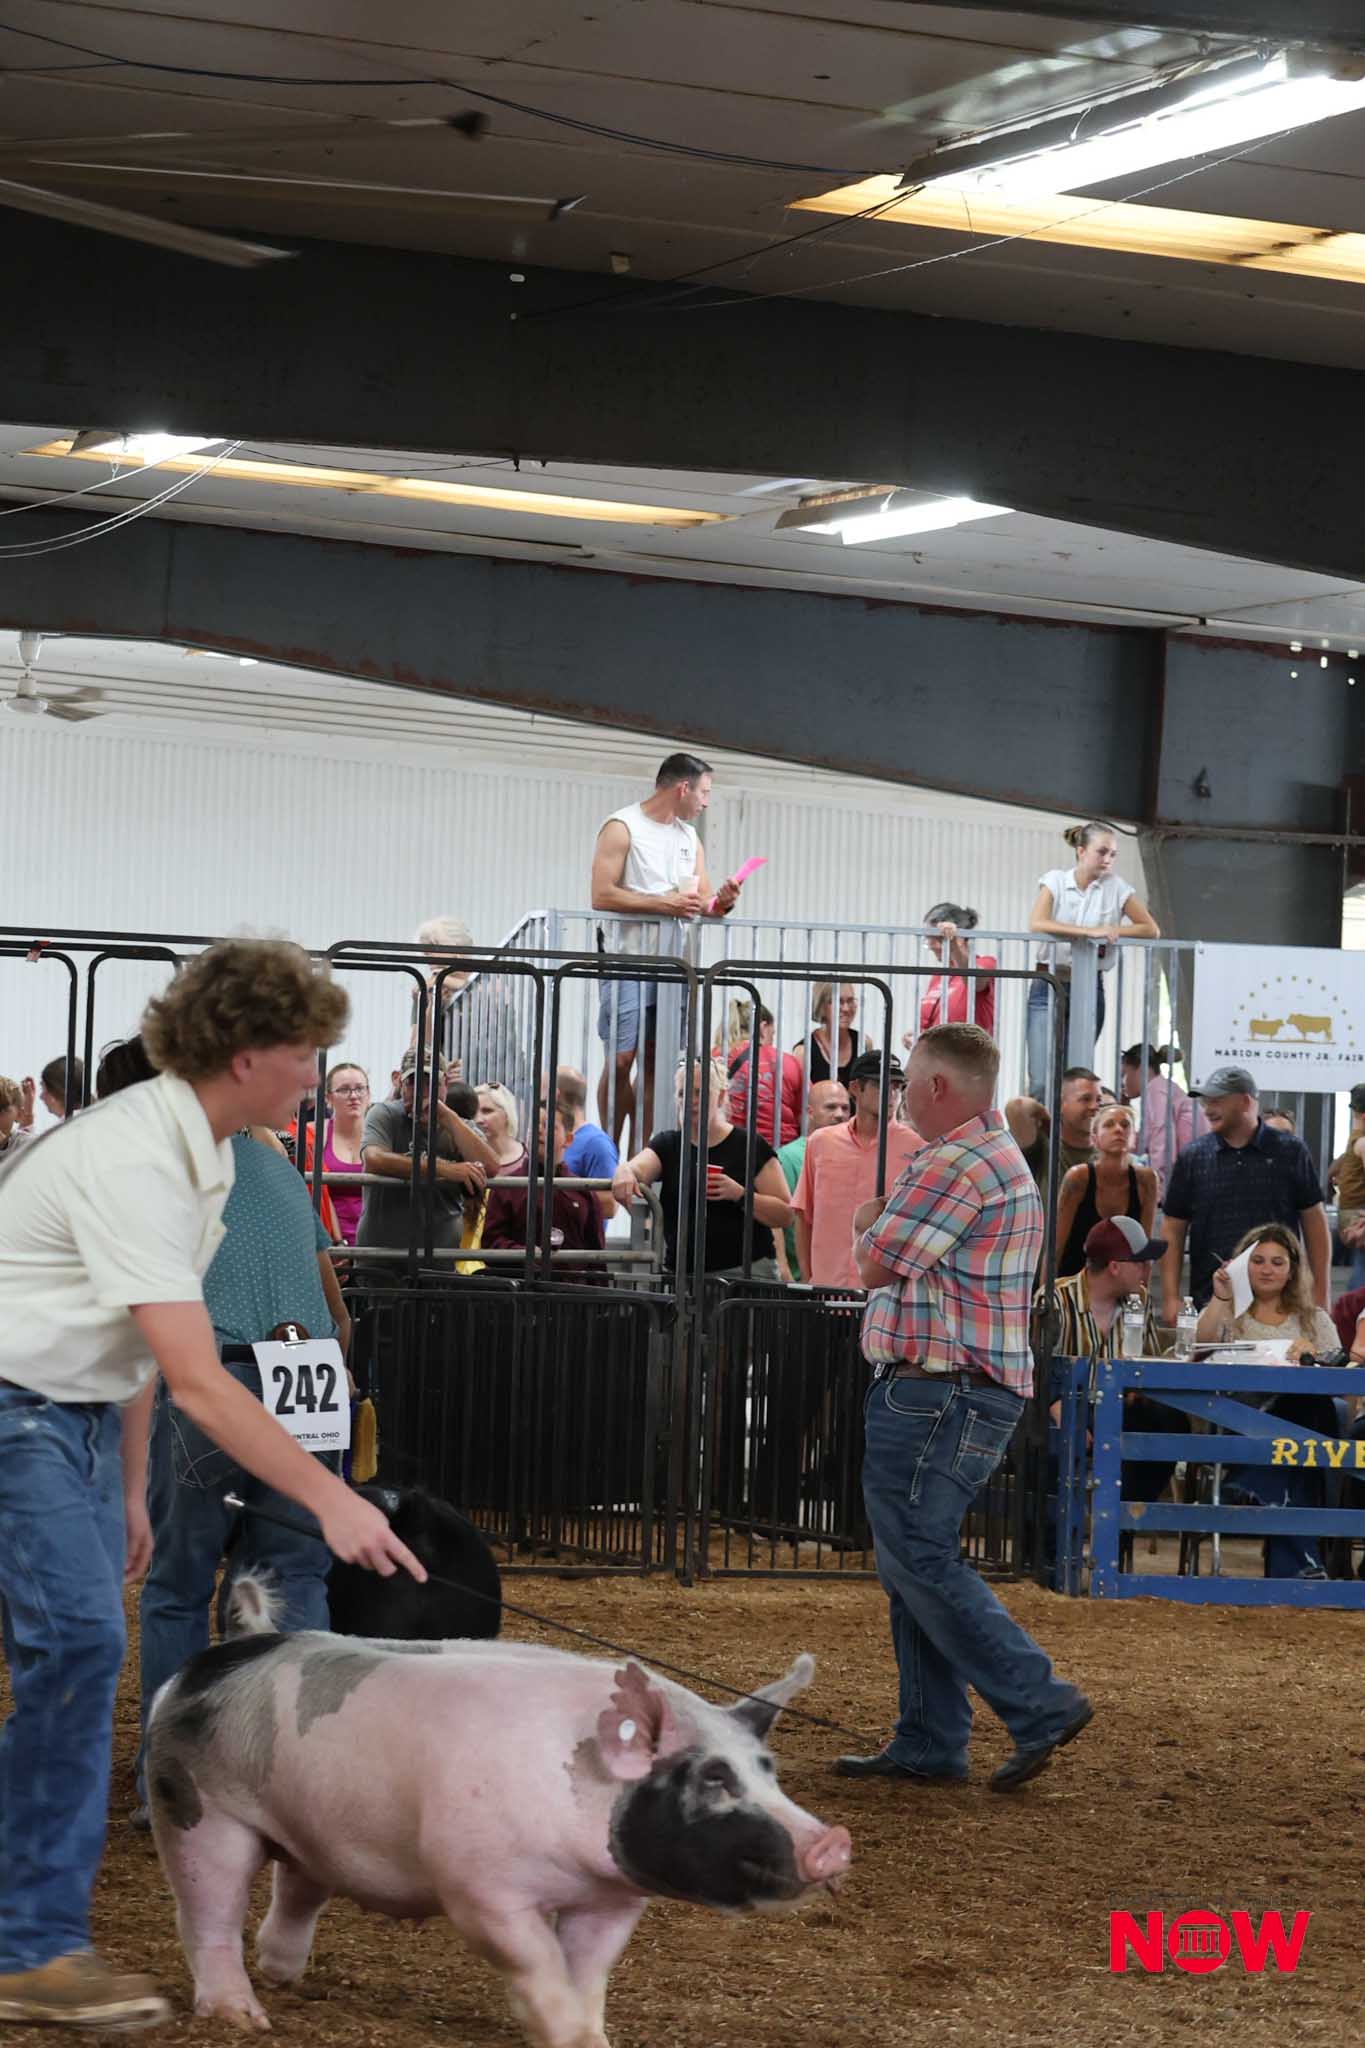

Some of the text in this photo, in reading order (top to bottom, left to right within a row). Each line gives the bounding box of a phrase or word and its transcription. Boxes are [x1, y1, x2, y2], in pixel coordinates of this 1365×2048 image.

[1214, 1049, 1260, 1057] MARION
[1265, 1050, 1311, 1060] COUNTY
[1338, 1053, 1364, 1062] FAIR
[272, 1363, 339, 1415] 242
[320, 1431, 340, 1439] OHIO
